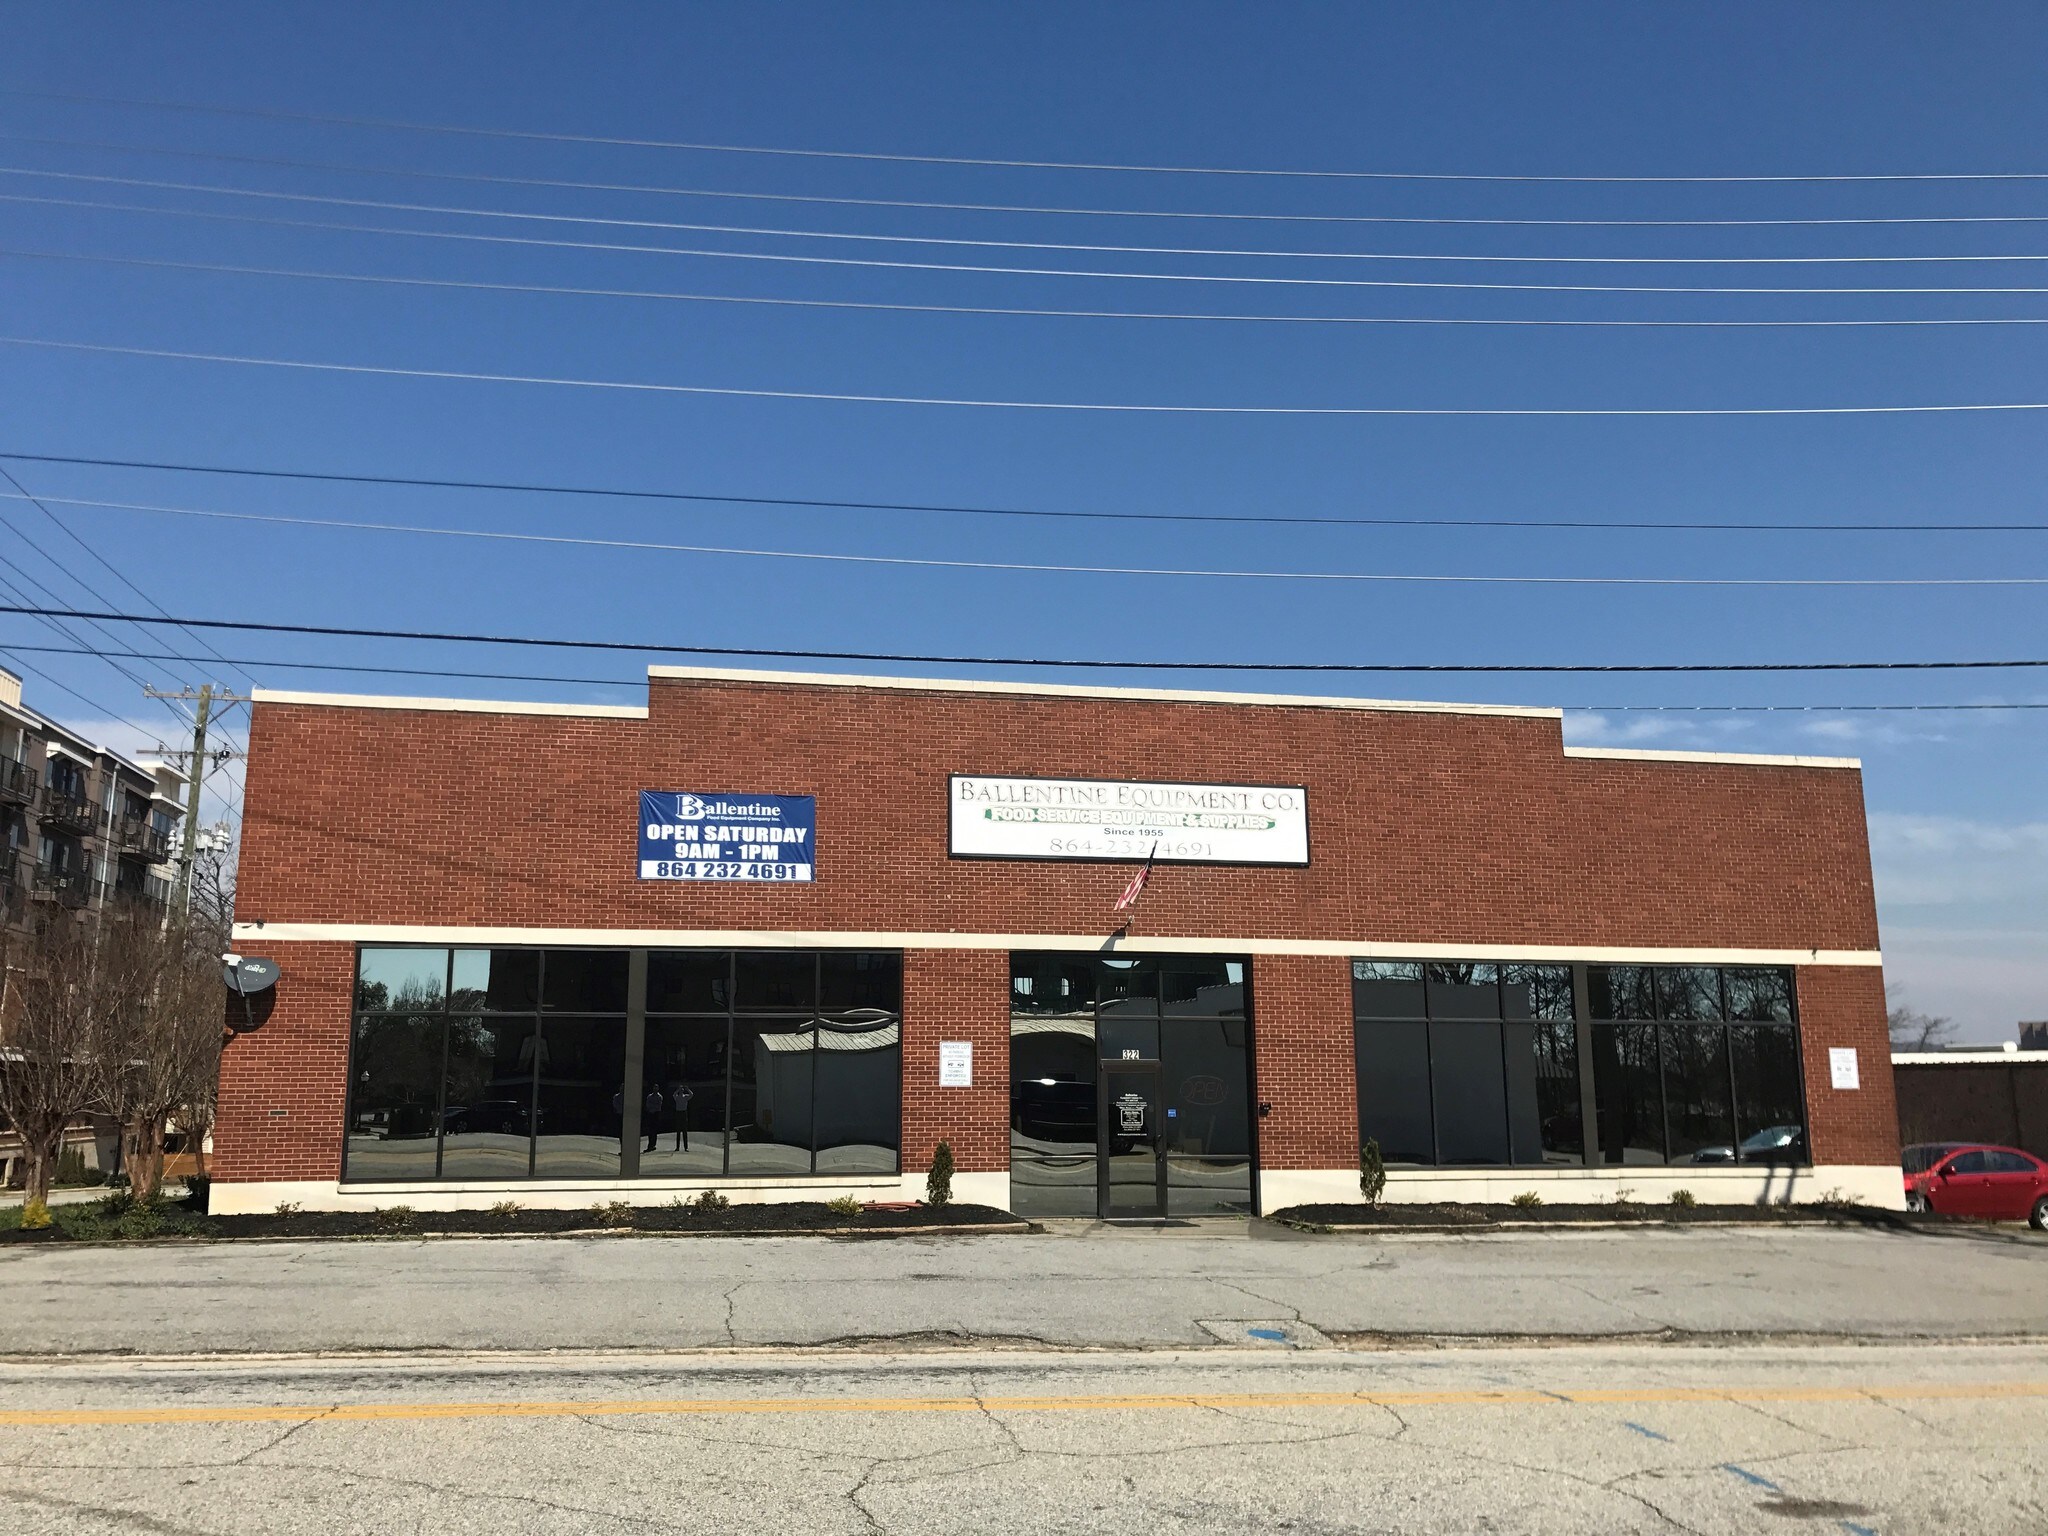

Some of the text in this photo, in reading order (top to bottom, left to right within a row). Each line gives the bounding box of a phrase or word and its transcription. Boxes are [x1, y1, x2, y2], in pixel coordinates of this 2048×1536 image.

[960, 780, 1299, 812] BALLENTINE EQUIPMENT CO.
[675, 794, 781, 821] Ballentine
[1200, 813, 1269, 830] SUPPLIES
[647, 824, 807, 843] OPEN SATURDAY
[1104, 827, 1164, 837] Since 1955
[675, 842, 720, 859] 9AM
[738, 844, 779, 860] 1PM
[1050, 838, 1212, 856] 864-2324691
[657, 862, 796, 879] 864 232 4691
[1123, 1049, 1138, 1060] 322
